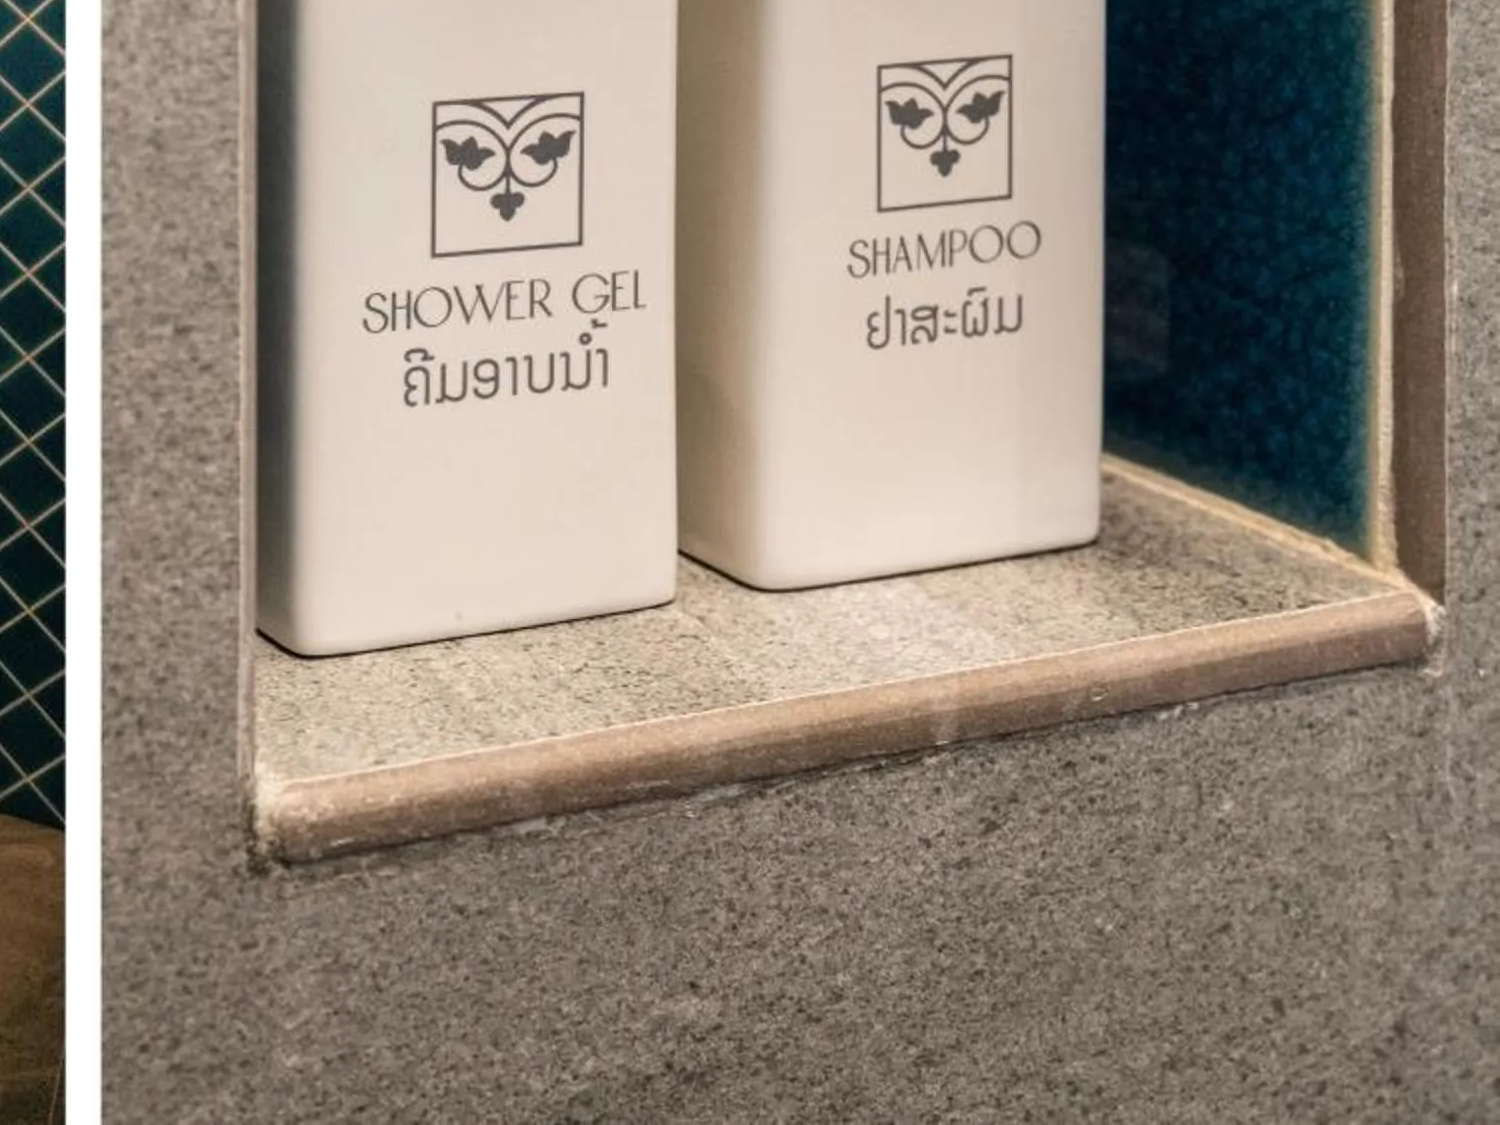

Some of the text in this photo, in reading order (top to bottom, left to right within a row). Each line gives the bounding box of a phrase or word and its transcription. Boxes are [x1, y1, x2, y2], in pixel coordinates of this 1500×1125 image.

[846, 220, 1042, 279] SHAMPOO
[361, 269, 647, 334] SHOWER GEL
[866, 285, 1024, 350] ຢາສະຜົມ
